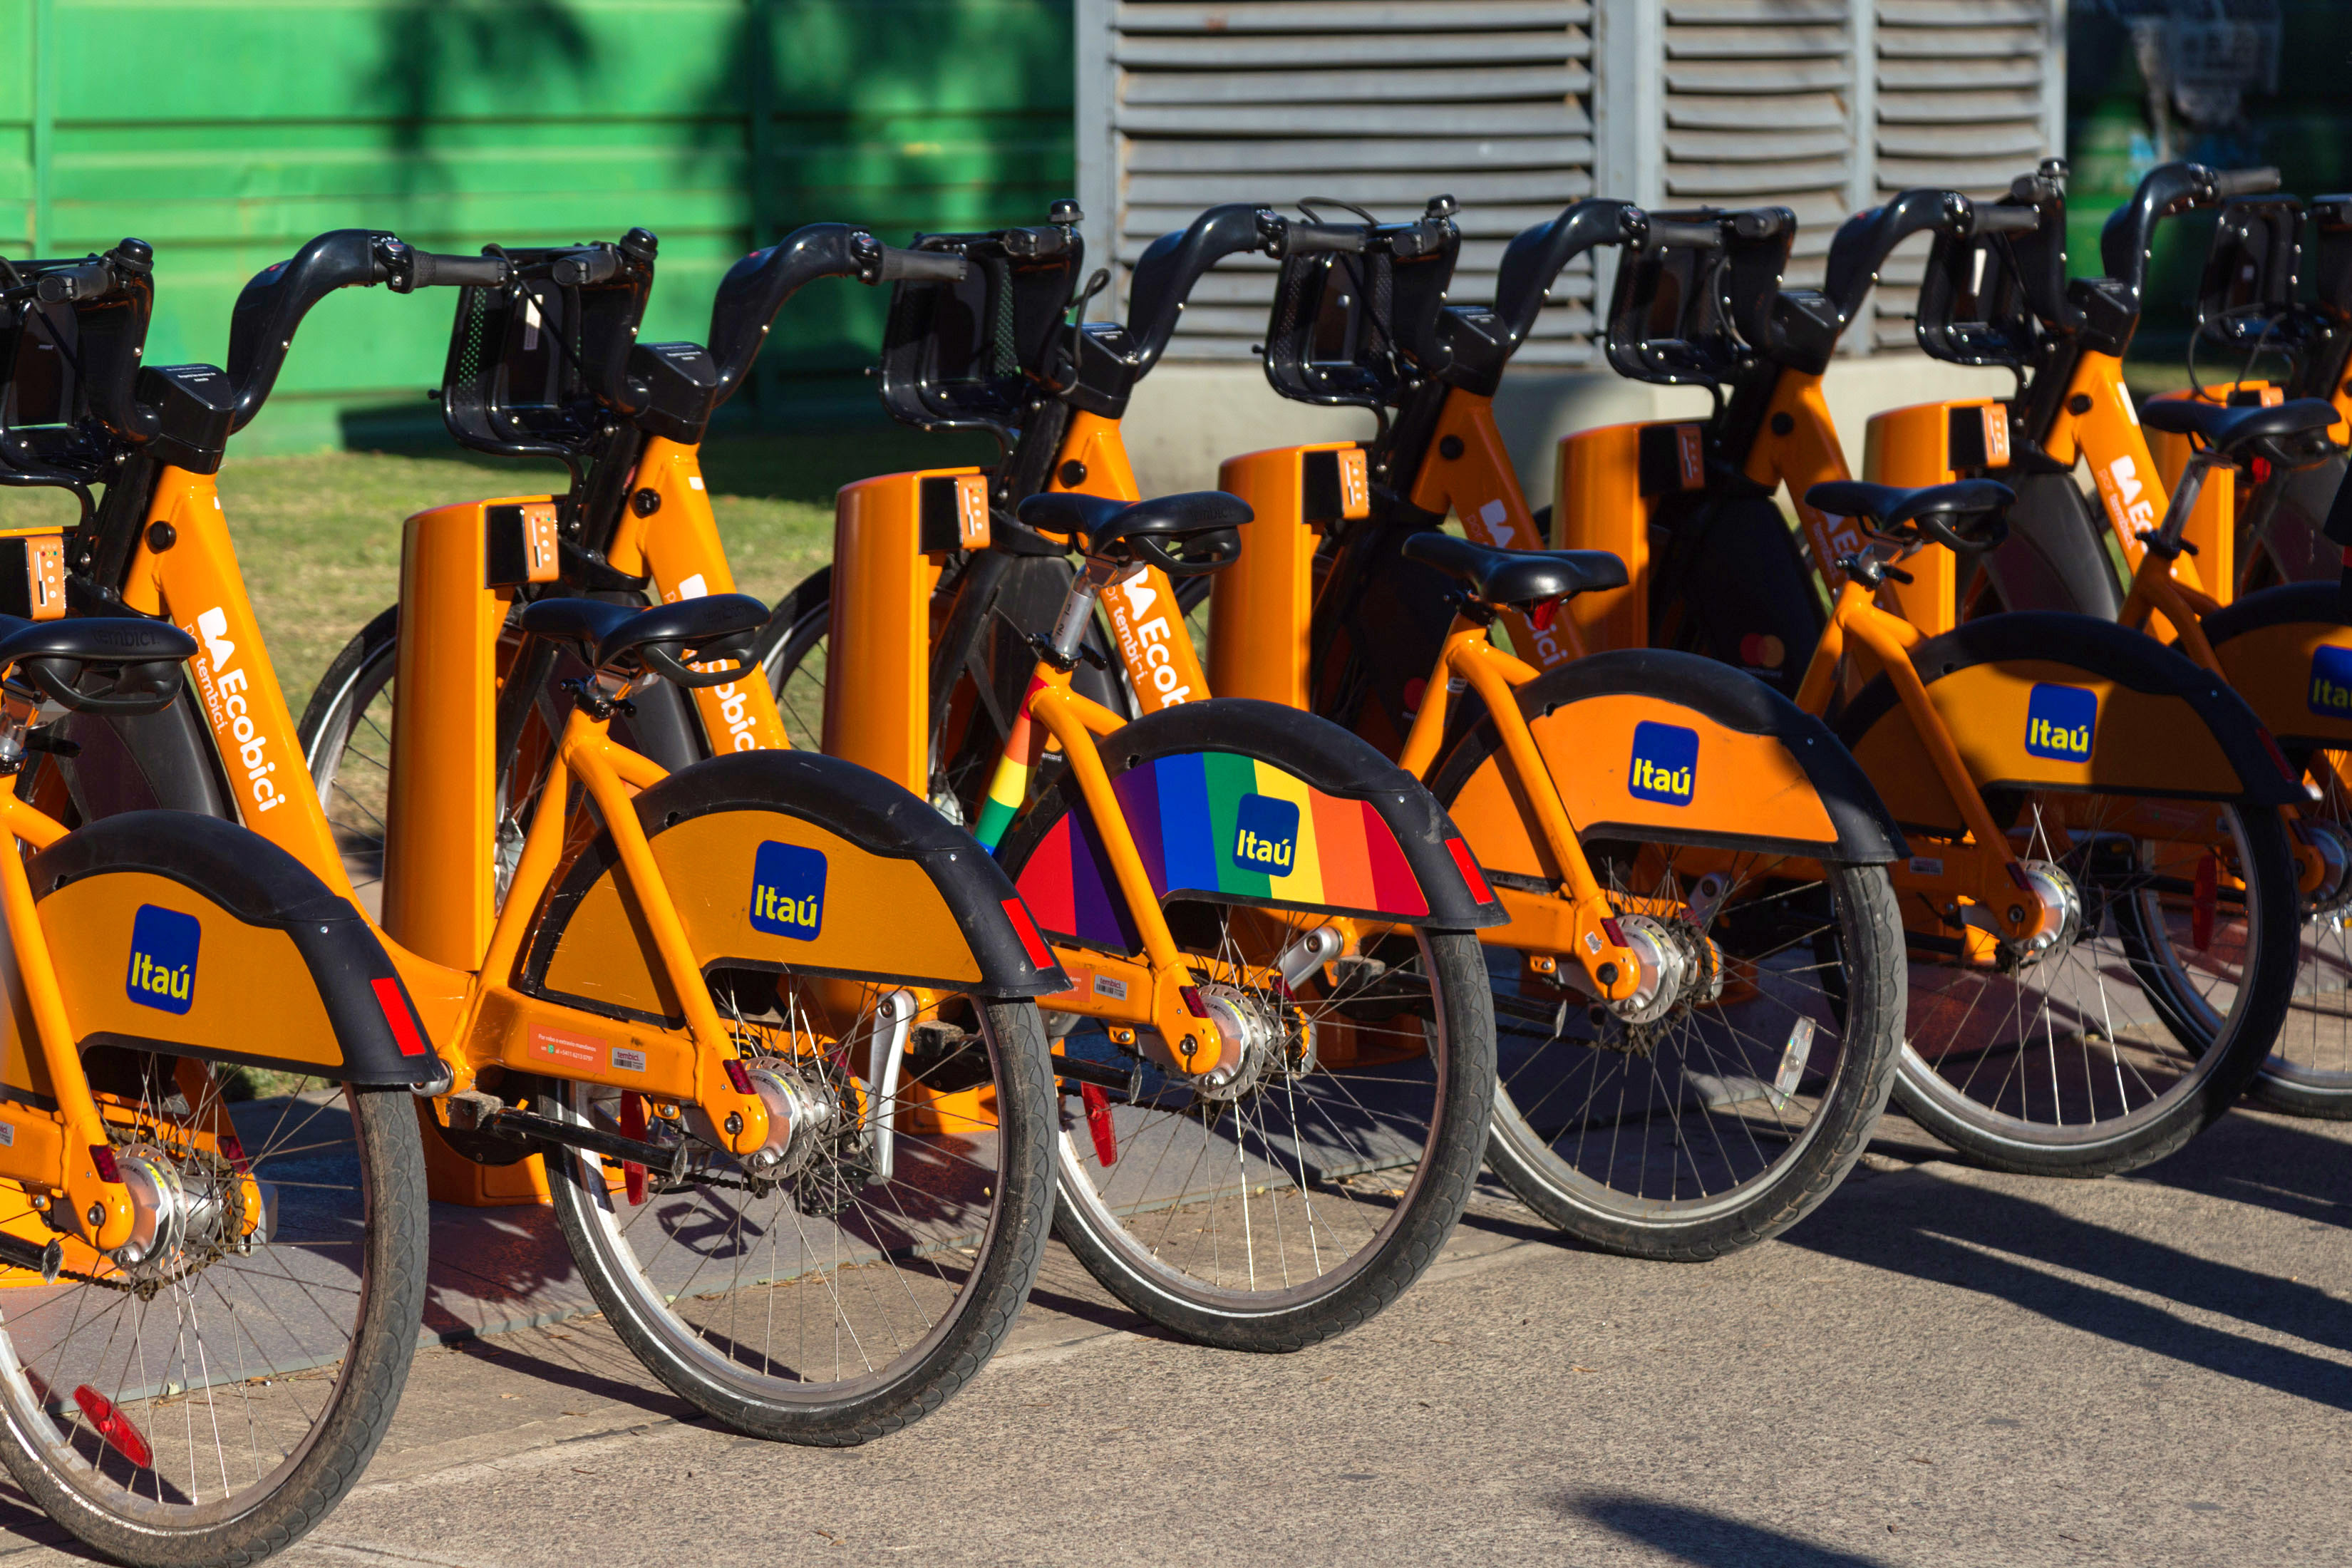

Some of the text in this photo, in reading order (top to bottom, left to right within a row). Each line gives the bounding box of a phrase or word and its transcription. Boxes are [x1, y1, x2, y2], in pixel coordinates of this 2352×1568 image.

[197, 606, 286, 813] BA Ecobici
[2313, 678, 2352, 708] Ita
[2031, 717, 2089, 753] Itaú
[1633, 758, 1691, 795] Itaú
[1237, 829, 1291, 867] Itaú
[755, 884, 817, 928] Itaú
[131, 951, 190, 1001] Itaú
